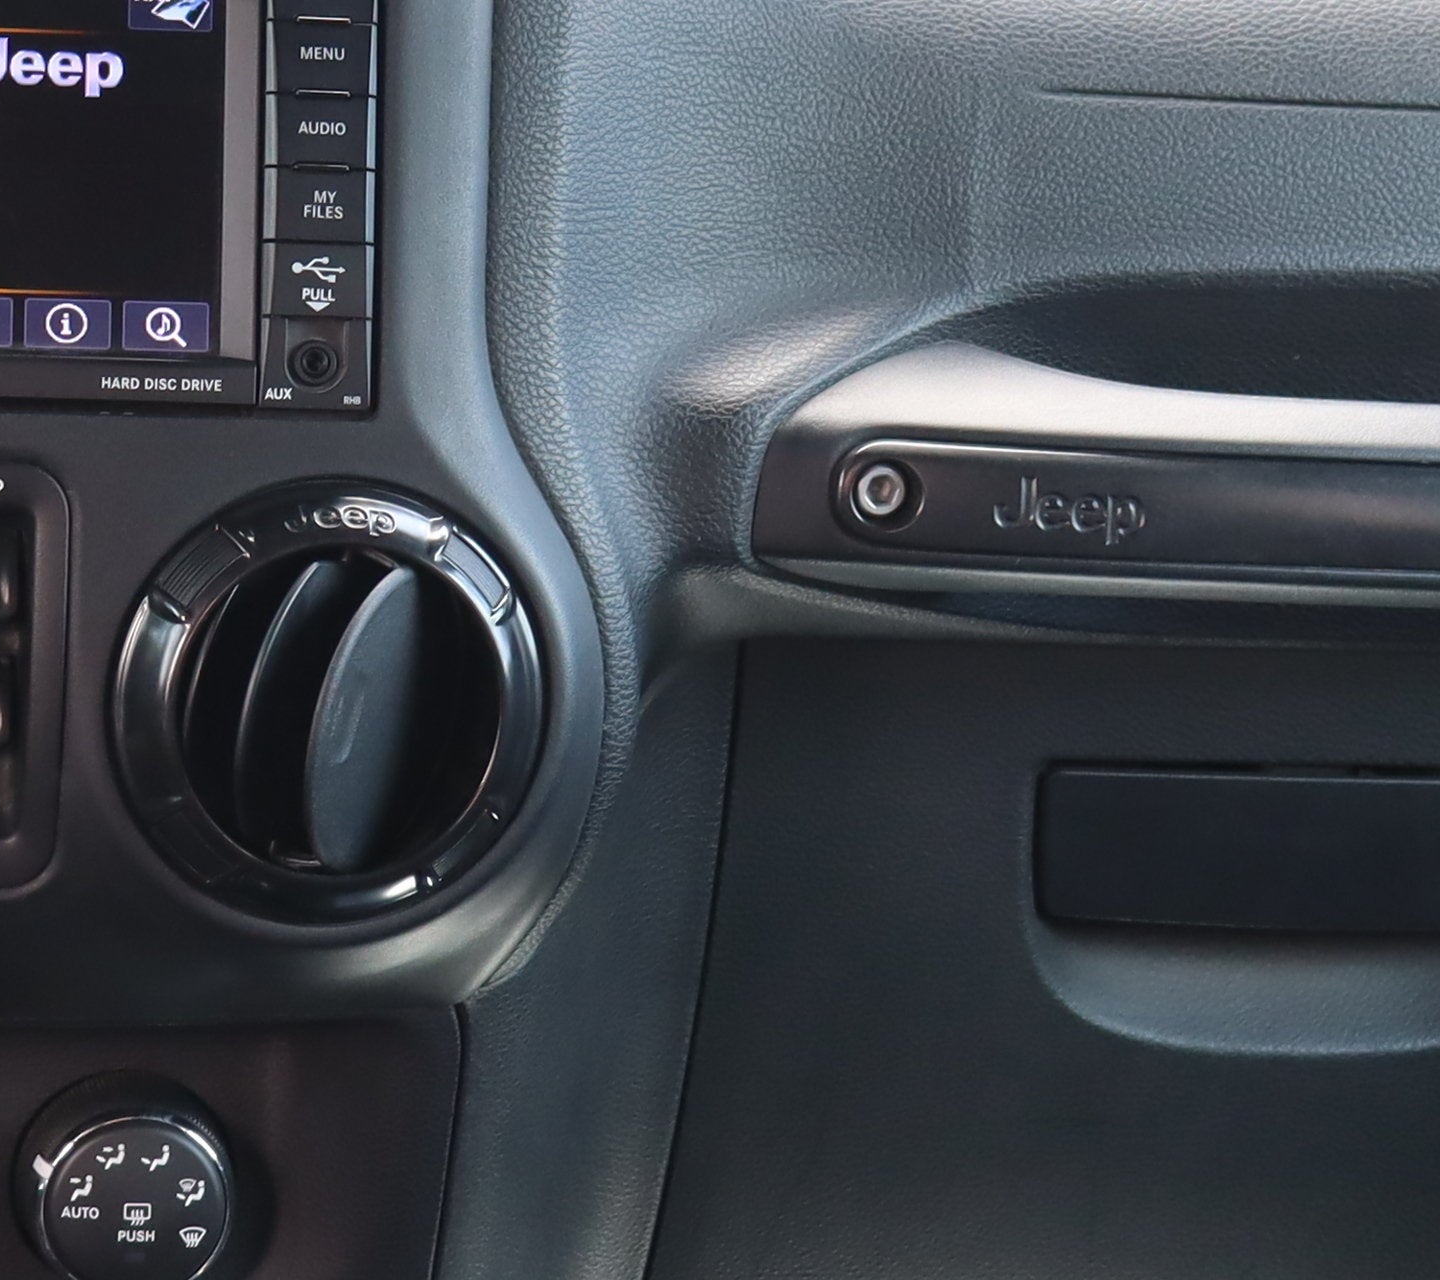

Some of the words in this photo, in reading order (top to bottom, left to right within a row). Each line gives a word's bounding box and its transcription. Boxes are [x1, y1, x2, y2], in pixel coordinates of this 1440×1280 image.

[299, 46, 346, 61] MENU
[298, 121, 346, 136] AUDIO
[313, 190, 338, 204] MY
[303, 205, 344, 220] FILES
[302, 288, 336, 302] PULL
[101, 376, 140, 390] HARD
[144, 377, 177, 391] DISC
[180, 378, 223, 392] DRIVE
[264, 387, 293, 401] AUX
[992, 475, 1147, 547] Jeep
[283, 504, 398, 537] Jeep
[60, 1206, 100, 1220] AUTO
[117, 1229, 156, 1243] PUSH
